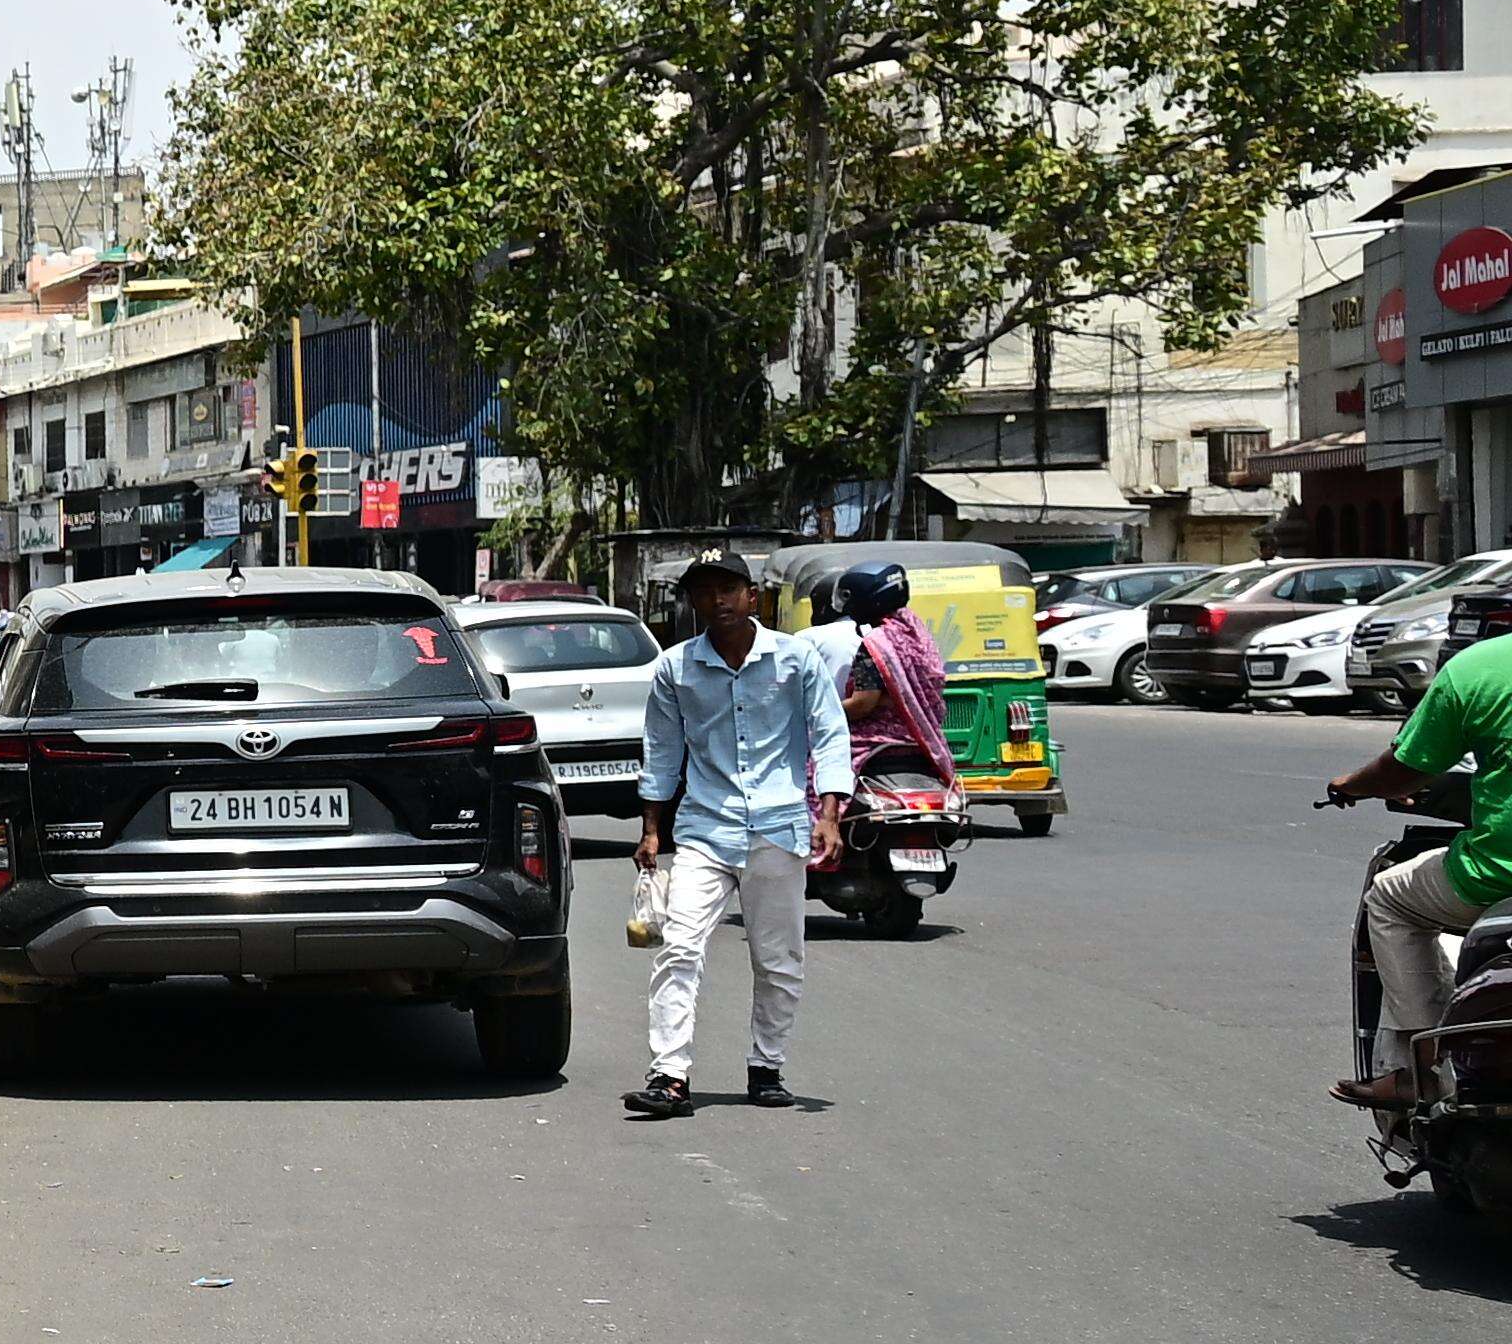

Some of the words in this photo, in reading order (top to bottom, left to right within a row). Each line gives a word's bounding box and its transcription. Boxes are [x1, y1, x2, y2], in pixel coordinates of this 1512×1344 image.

[1441, 260, 1462, 292] Jal
[1464, 248, 1510, 285] Mahal
[1421, 338, 1454, 356] GELATO
[190, 797, 218, 822] 24
[228, 796, 256, 821] BH
[263, 795, 322, 820] 1054
[330, 795, 342, 819] N
